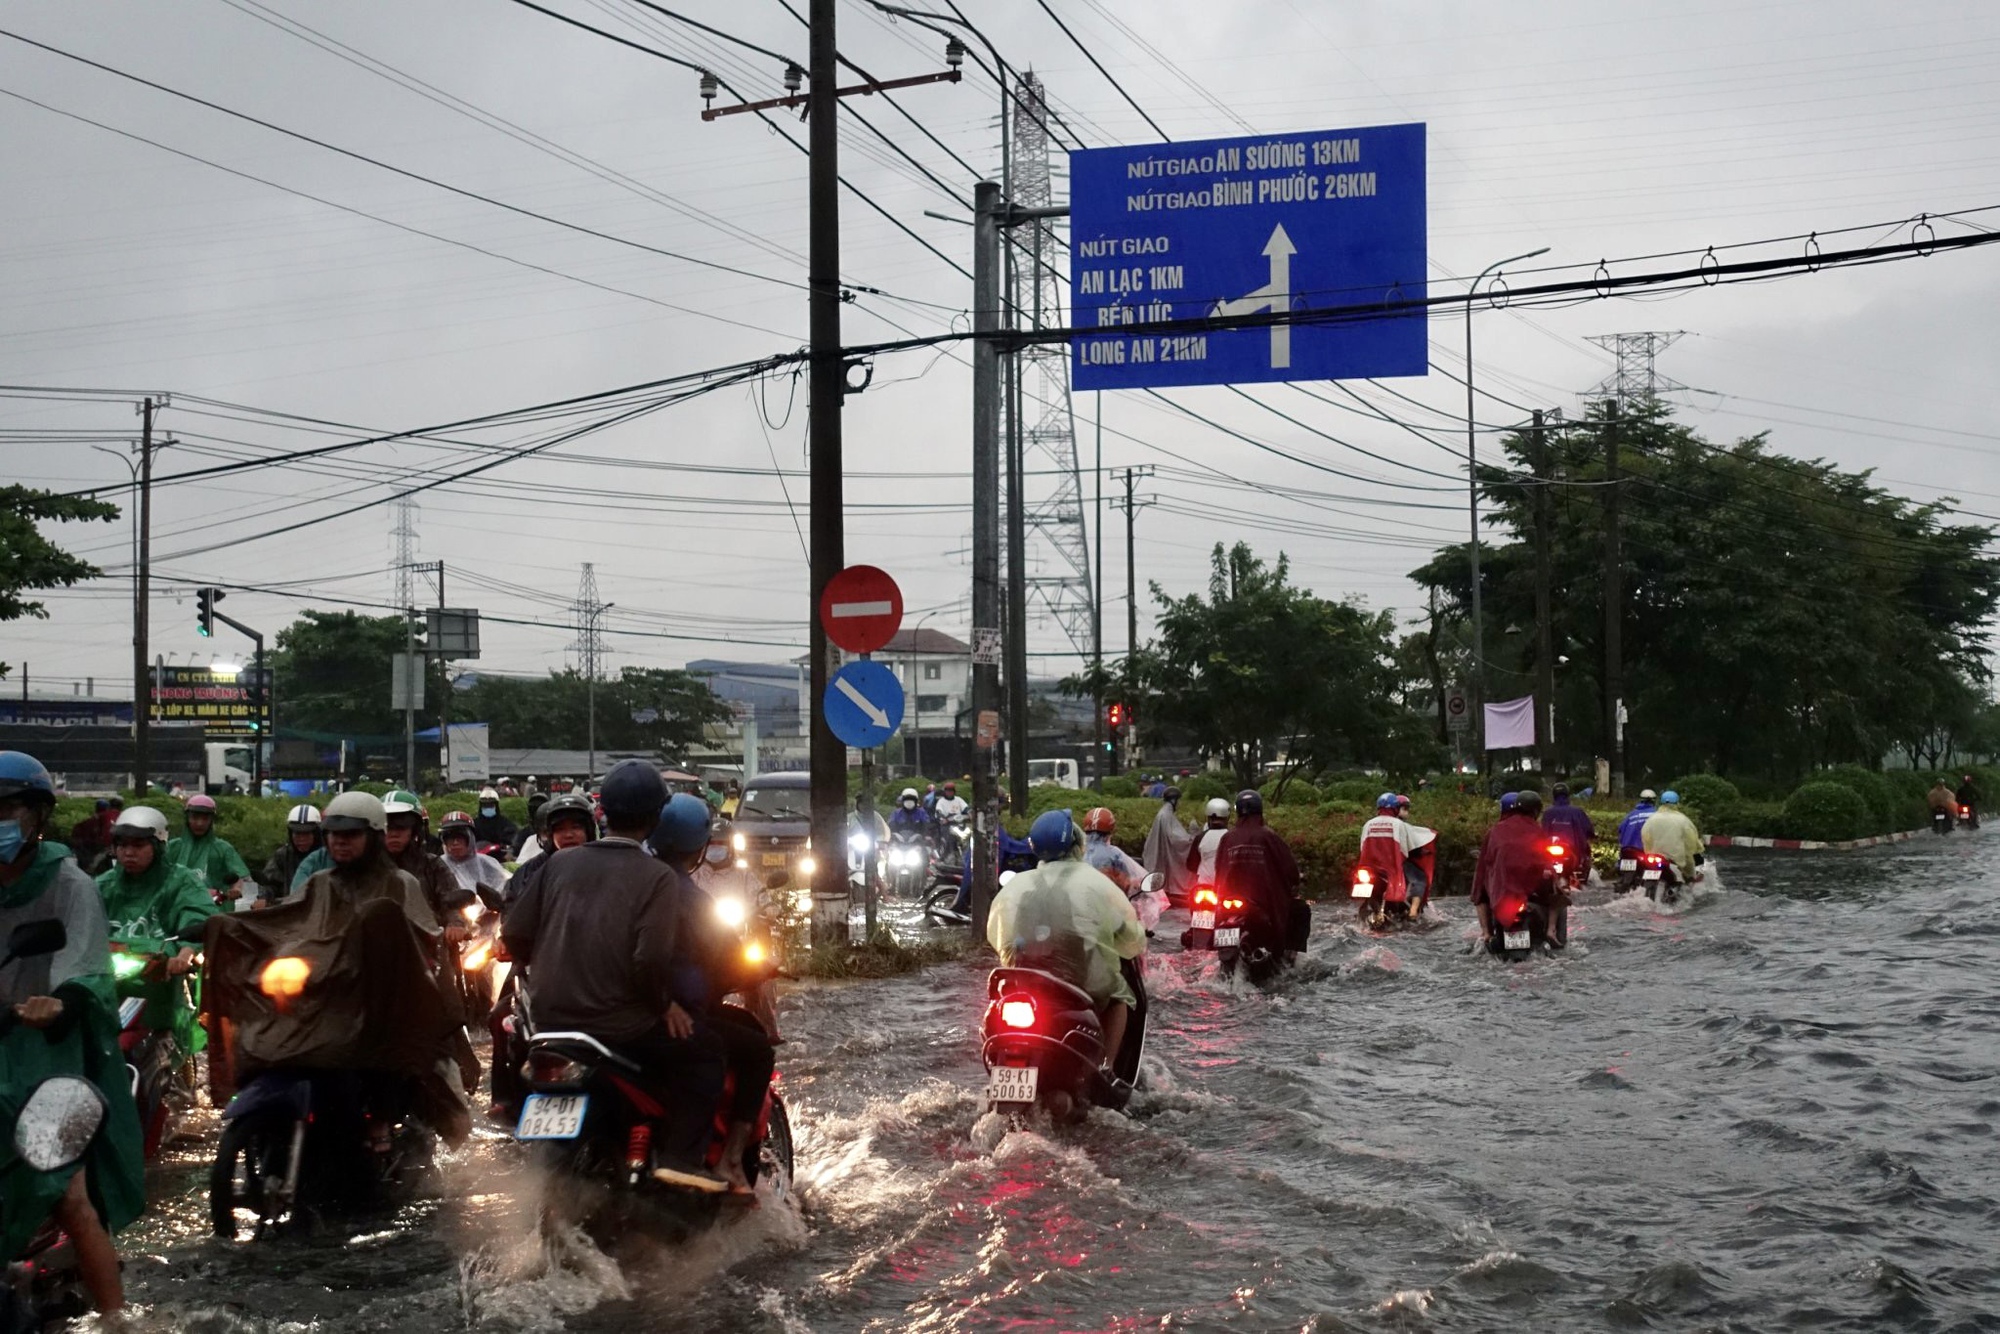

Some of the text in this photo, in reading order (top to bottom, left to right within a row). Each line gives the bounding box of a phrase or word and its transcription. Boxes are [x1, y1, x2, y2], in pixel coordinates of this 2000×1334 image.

[1216, 148, 1241, 172] AN
[1246, 140, 1306, 171] SƯƠNG
[1311, 138, 1360, 166] 13KM
[1212, 177, 1253, 207] BÌNH
[1258, 170, 1319, 204] PHƯỚC
[1324, 171, 1377, 200] 26KM
[1080, 233, 1169, 258] NÚT GIAO
[1080, 265, 1184, 297] AN LẠC 1KM
[1080, 336, 1207, 366] LONG AN 21KM
